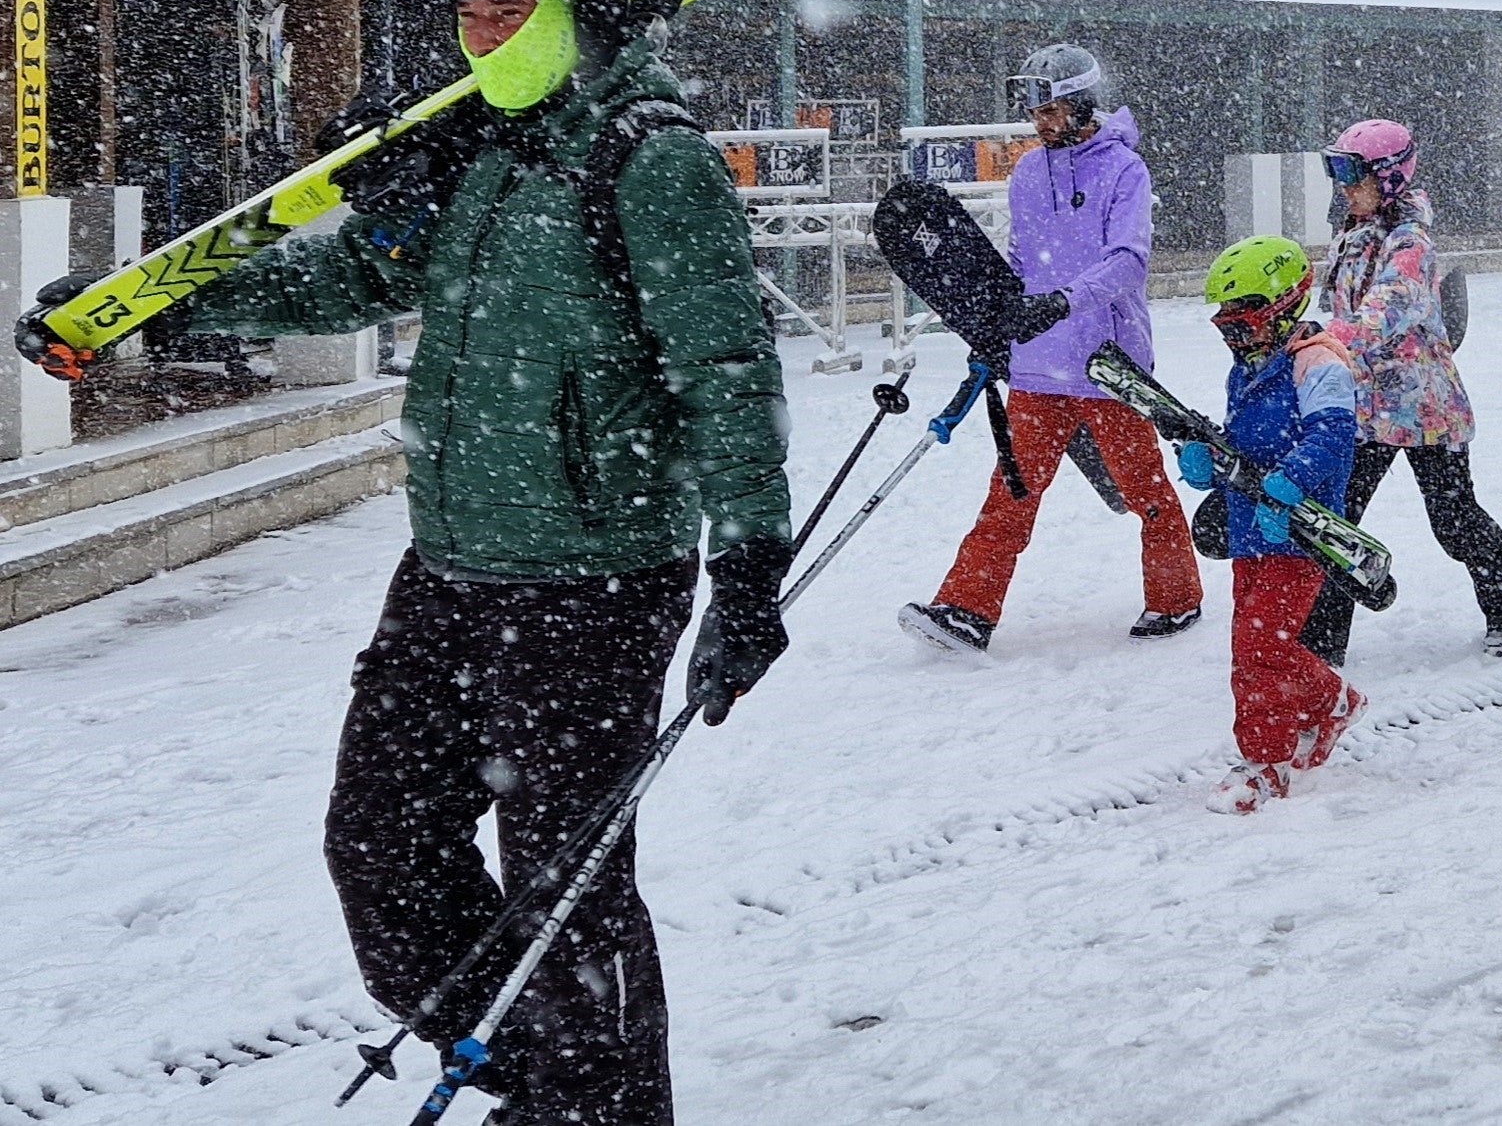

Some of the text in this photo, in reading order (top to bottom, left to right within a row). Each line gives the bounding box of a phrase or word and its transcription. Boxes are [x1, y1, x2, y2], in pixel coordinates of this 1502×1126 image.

[769, 169, 806, 183] SNOW
[927, 167, 963, 180] SNOW
[86, 294, 133, 328] 13
